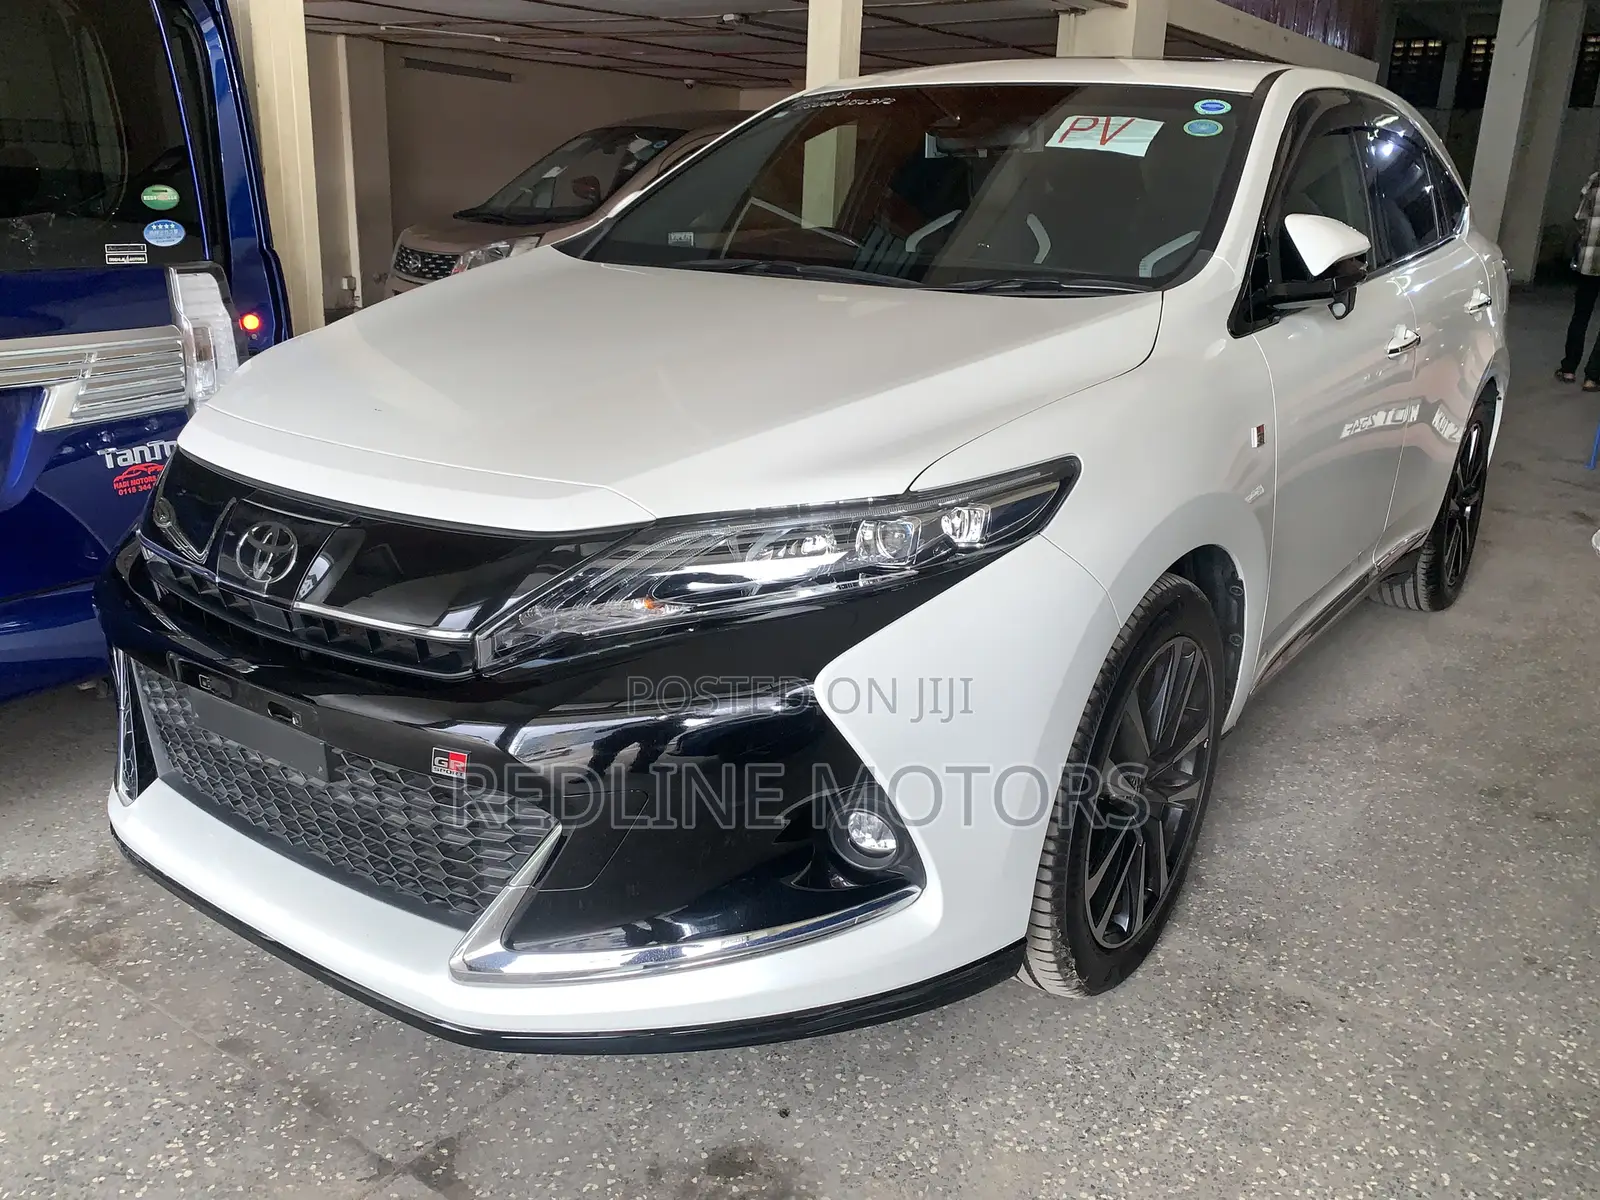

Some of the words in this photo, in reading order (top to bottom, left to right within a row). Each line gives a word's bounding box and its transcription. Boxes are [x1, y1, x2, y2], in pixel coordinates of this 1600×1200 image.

[1058, 116, 1135, 145] PV
[130, 475, 157, 486] MOTORS
[434, 756, 466, 773] GR
